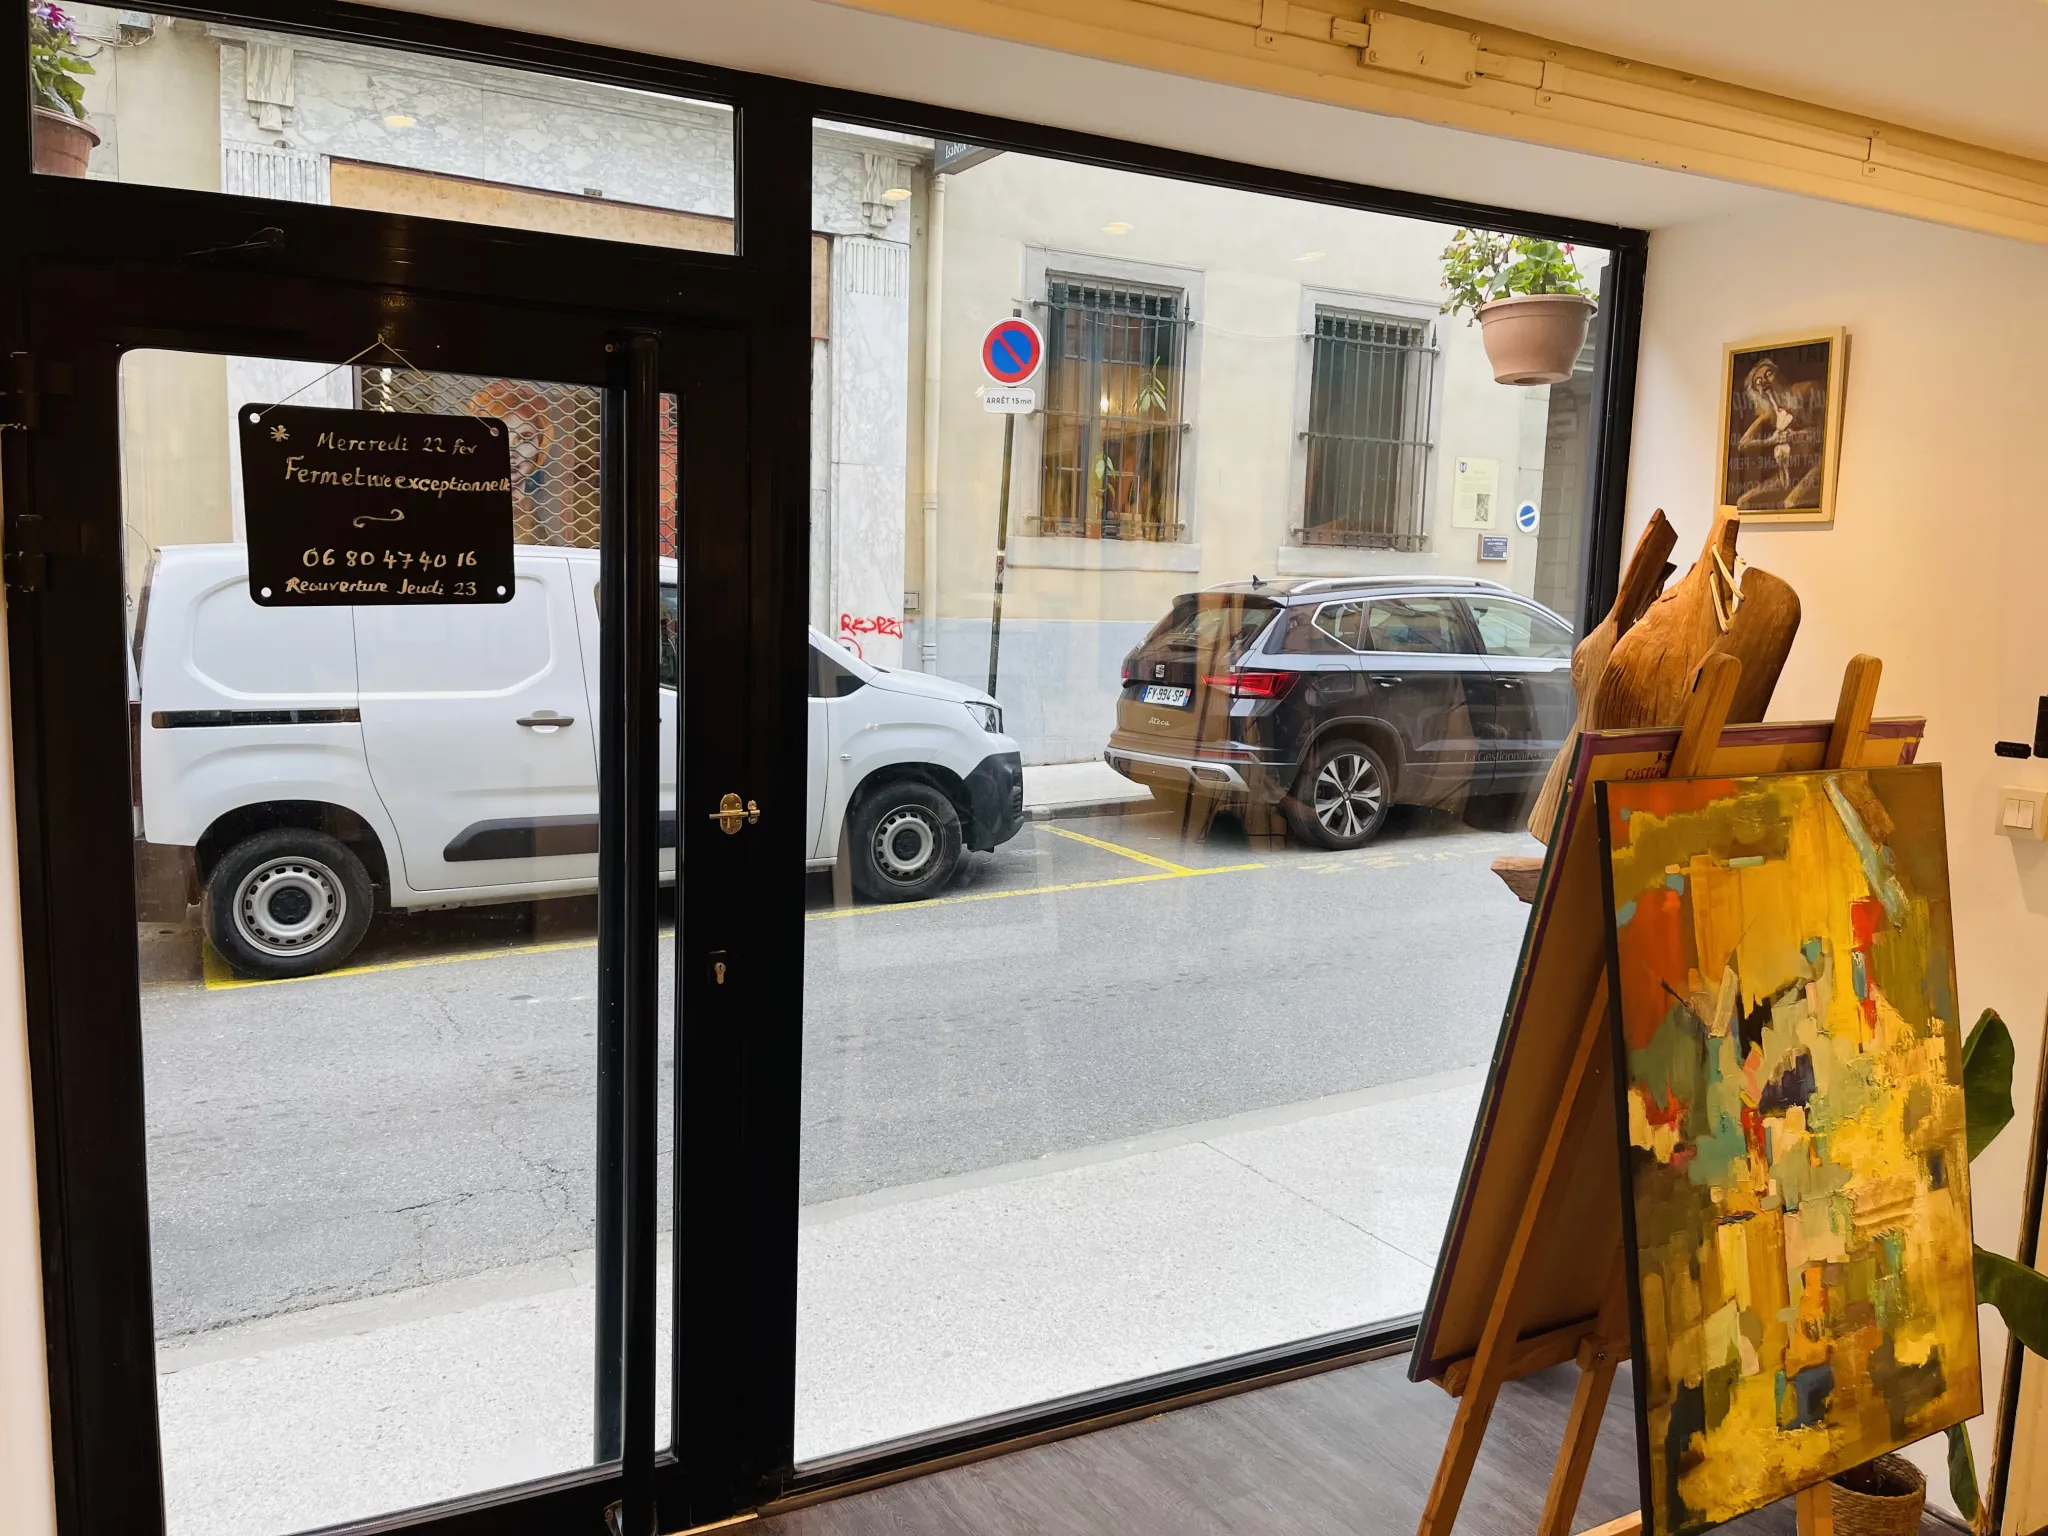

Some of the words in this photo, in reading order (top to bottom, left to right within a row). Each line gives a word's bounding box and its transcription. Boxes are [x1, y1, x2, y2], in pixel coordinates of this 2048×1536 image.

[986, 395, 1010, 405] ARRÊT
[1011, 397, 1020, 405] 15
[1020, 397, 1032, 405] min
[316, 432, 409, 451] Mercredi
[422, 437, 446, 452] 22
[285, 455, 392, 487] Fermeture
[303, 548, 336, 567] 06
[346, 551, 375, 566] 80
[383, 550, 414, 569] 47
[419, 551, 447, 572] 40
[457, 551, 478, 567] 16
[396, 579, 444, 595] Jeudi
[453, 582, 477, 596] 23
[1148, 716, 1171, 726] Ateca
[1463, 751, 1476, 762] La
[1478, 750, 1537, 761] Gestionnaire
